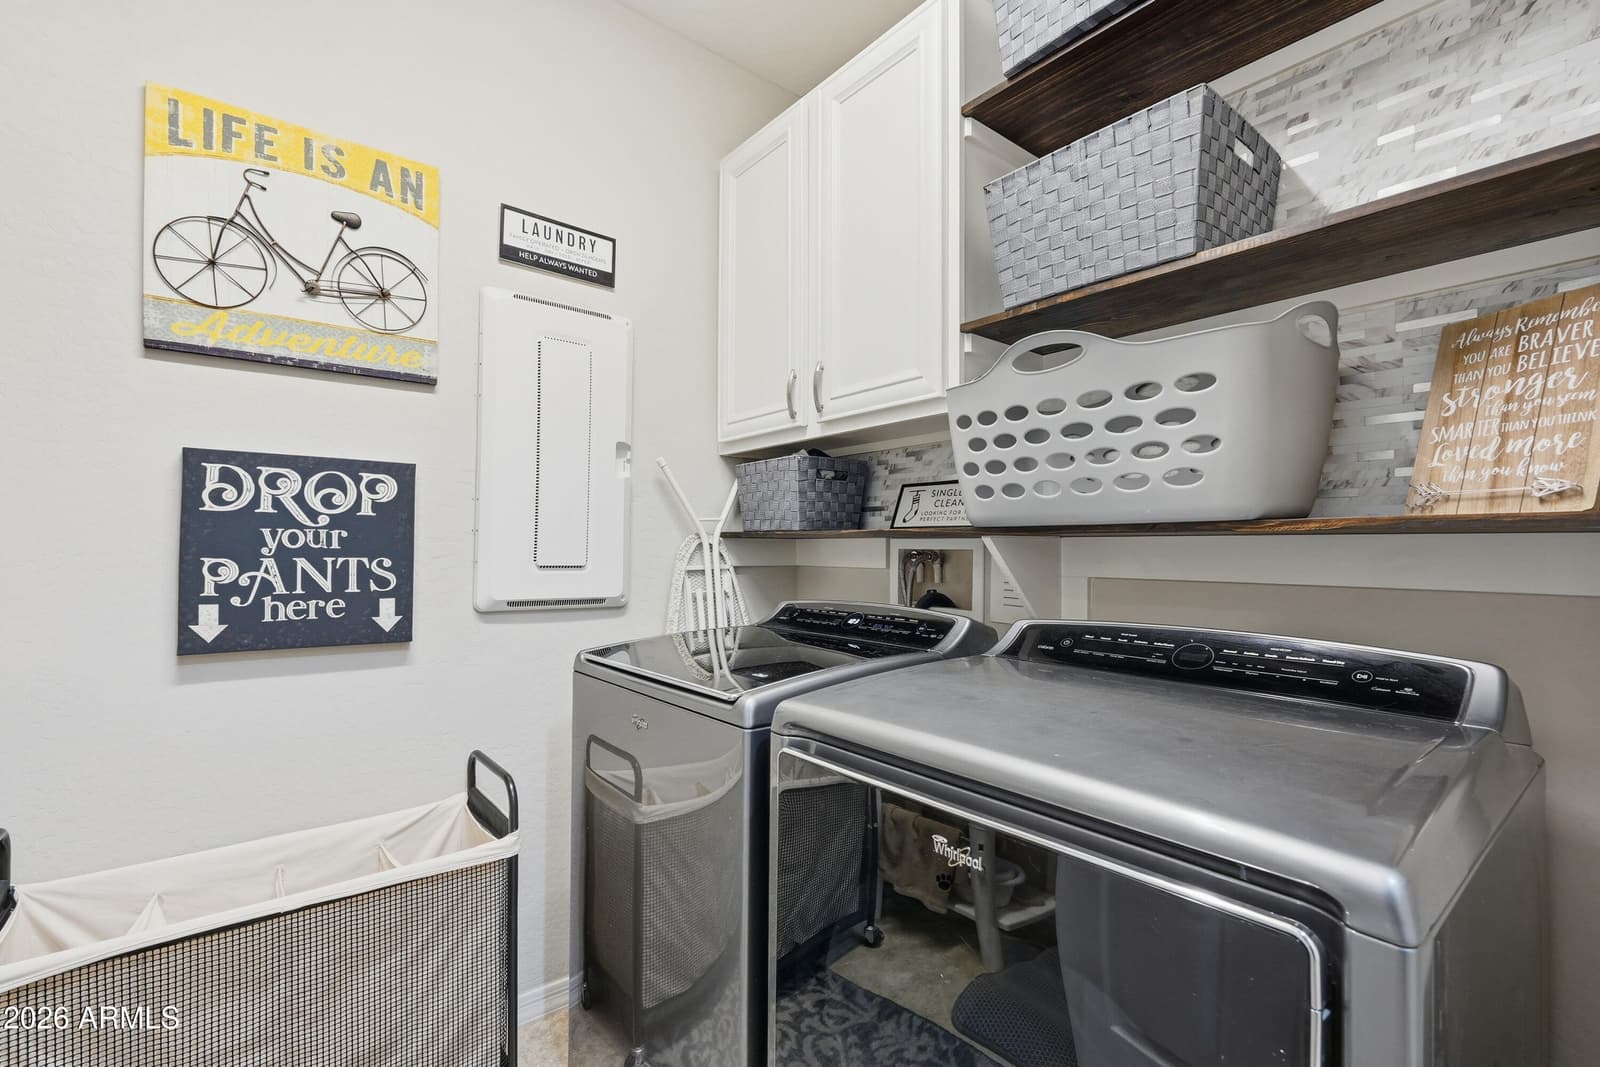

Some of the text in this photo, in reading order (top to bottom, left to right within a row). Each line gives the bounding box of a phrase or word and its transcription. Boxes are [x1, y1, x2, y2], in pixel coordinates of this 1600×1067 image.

[167, 97, 424, 211] LIFE IS AN
[521, 217, 597, 253] LAUNDRY
[519, 250, 538, 261] HELP
[538, 256, 567, 270] ALWAYS
[567, 263, 598, 278] WANTED
[170, 311, 424, 369] Adventure
[1451, 325, 1513, 350] Always
[1463, 319, 1594, 366] YOU ARE BRAVER
[1453, 338, 1600, 385] THAN YOU BELIEVE
[1520, 397, 1553, 416] you
[1554, 388, 1598, 407] seem
[1429, 410, 1598, 445] SMARTER THAN YOU THINK
[1427, 431, 1586, 468] Loved more
[1479, 465, 1512, 482] you
[1515, 456, 1568, 478] know
[199, 462, 398, 527] DROP
[259, 527, 349, 556] your
[200, 556, 397, 607] PANTS
[261, 596, 346, 622] here
[931, 834, 984, 871] Whirlpool
